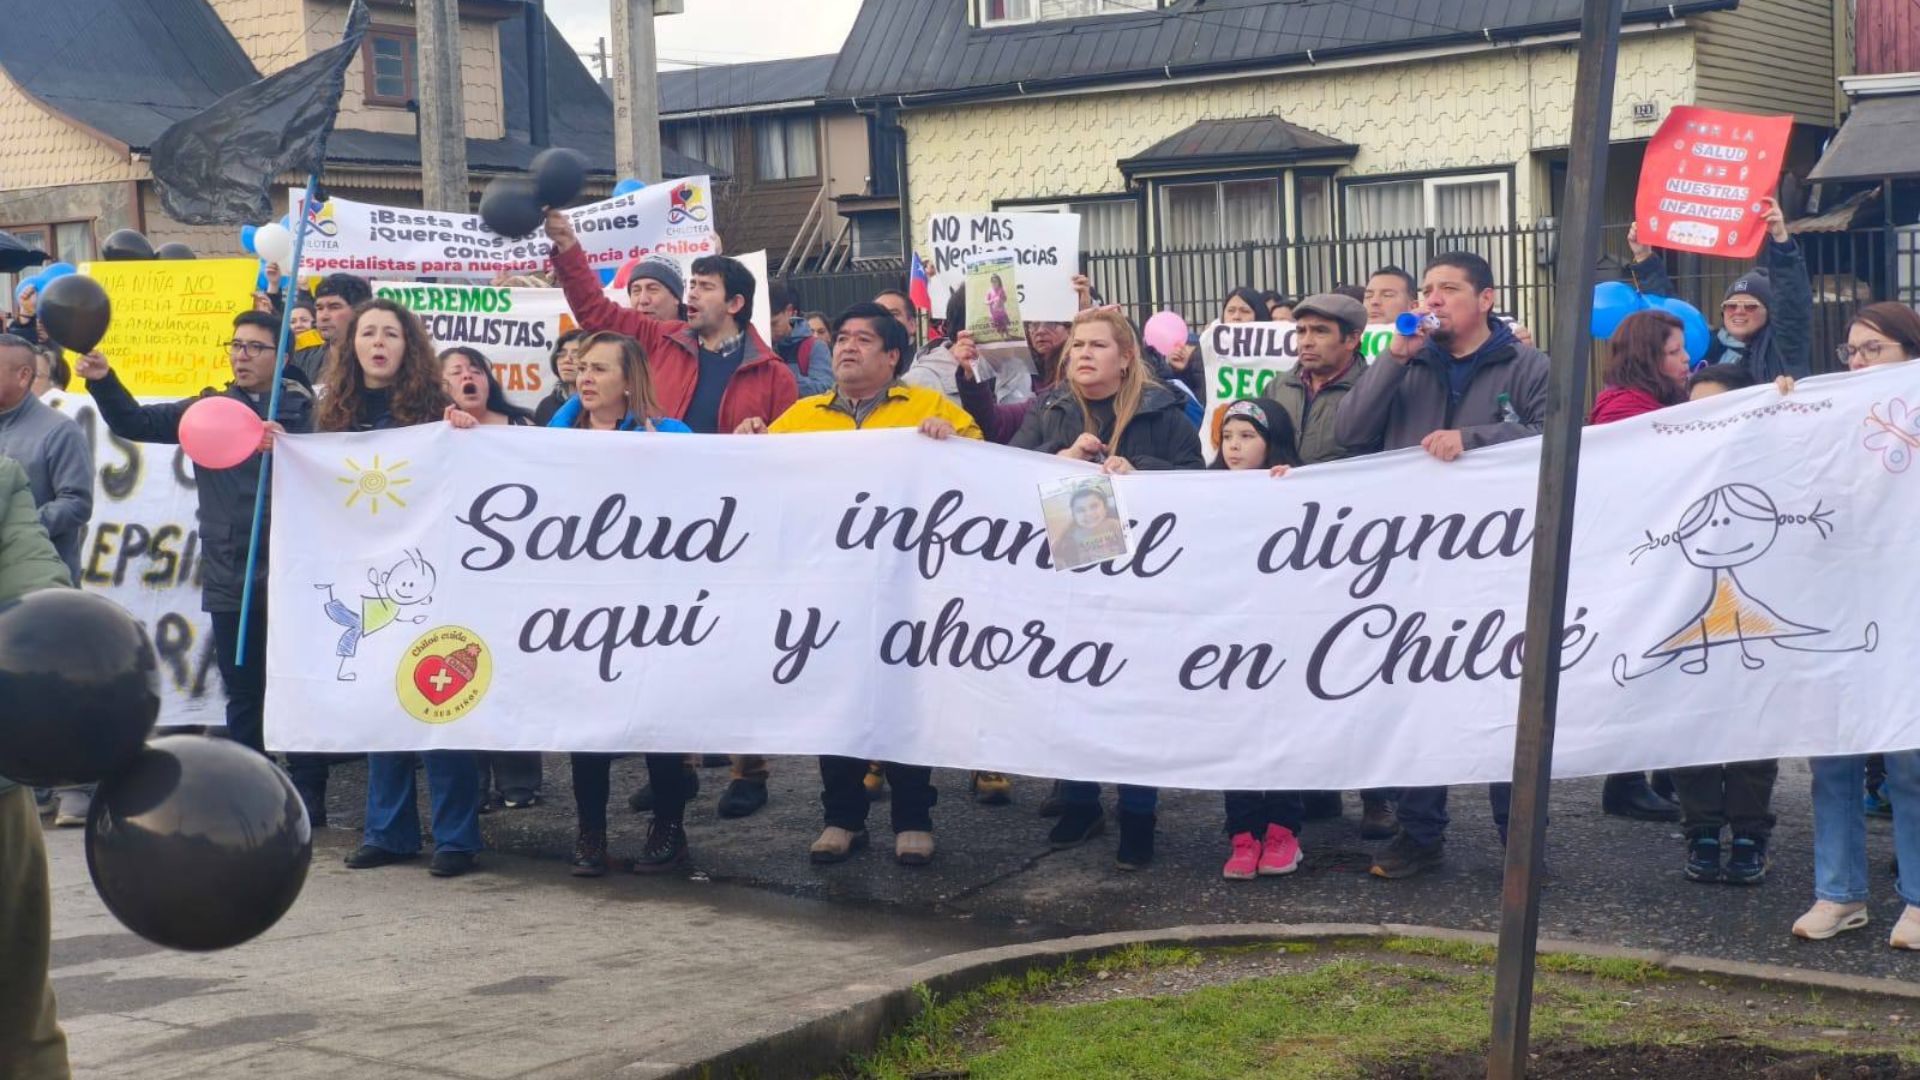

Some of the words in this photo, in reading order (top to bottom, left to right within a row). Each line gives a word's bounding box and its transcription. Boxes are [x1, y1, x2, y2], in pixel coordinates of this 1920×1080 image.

[1694, 143, 1747, 161] SALUD
[1667, 179, 1749, 200] NUESTRAS
[1660, 199, 1743, 220] INFANCIAS
[370, 209, 454, 229] ¡Basta
[461, 218, 491, 234] de
[932, 216, 961, 243] NO
[970, 216, 1014, 243] MAS
[370, 227, 504, 249] ¡Queremos
[421, 259, 463, 274] para
[468, 258, 537, 272] nuestra
[629, 246, 649, 258] de
[443, 243, 553, 260] concreta
[184, 274, 214, 294] NO
[424, 314, 553, 350] ECIALISTAS,
[456, 484, 749, 571] Salud
[836, 490, 1184, 580] infanl
[1258, 502, 1534, 598] digna
[519, 589, 720, 682] aquí
[773, 607, 840, 684] y
[880, 597, 1128, 687] ahora
[1179, 643, 1287, 690] en
